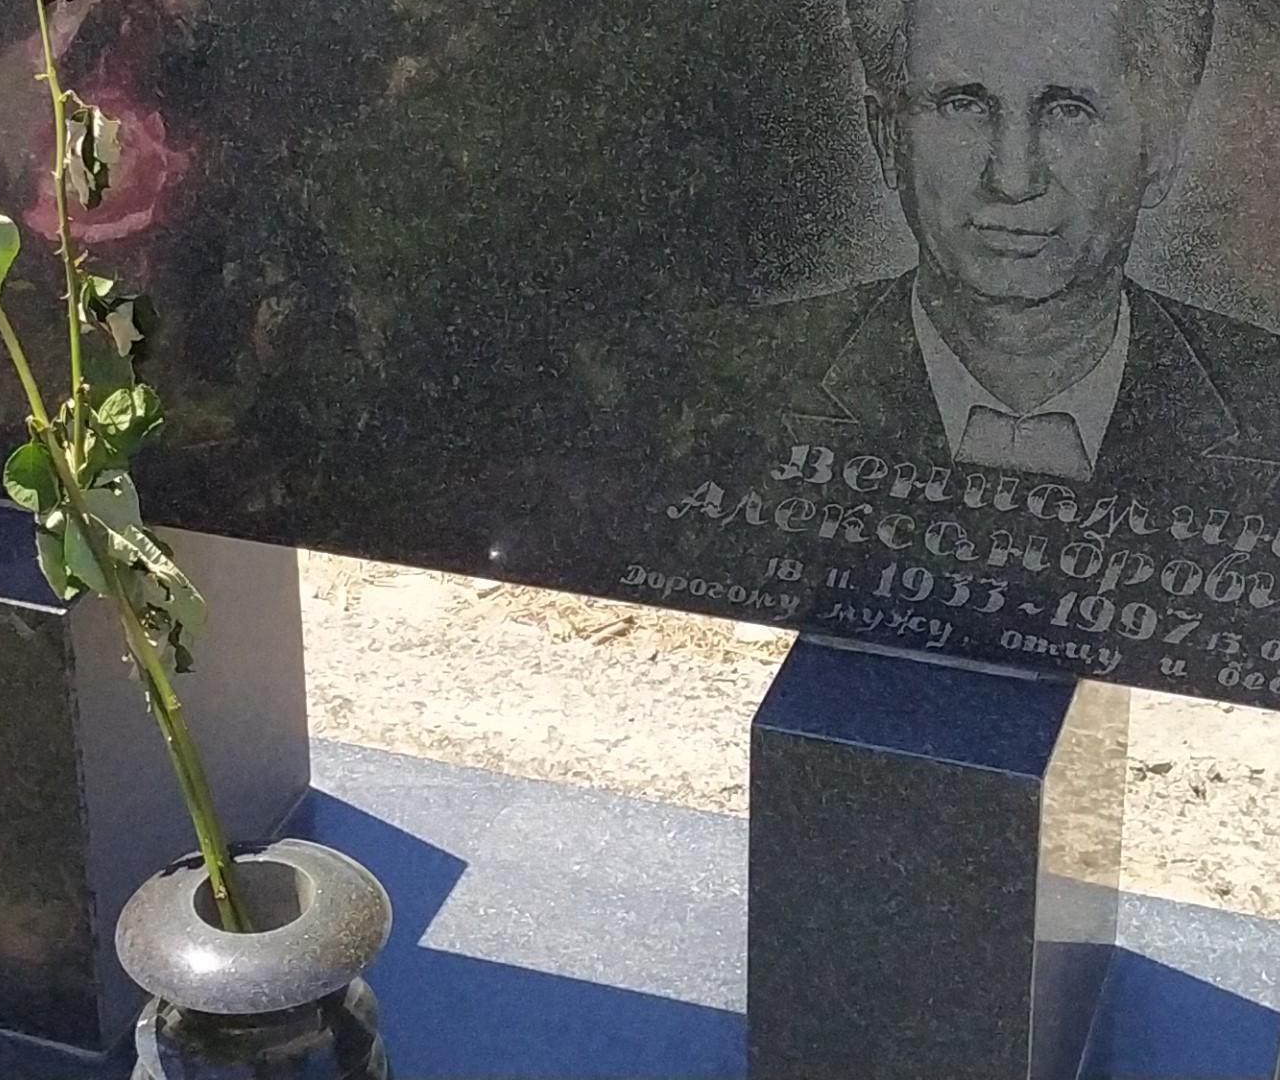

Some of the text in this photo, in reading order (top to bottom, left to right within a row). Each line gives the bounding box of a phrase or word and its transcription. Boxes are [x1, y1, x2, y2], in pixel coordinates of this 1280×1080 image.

[762, 556, 804, 583] 18
[620, 563, 801, 620] Дорогому
[1000, 628, 1122, 675] отцу
[1160, 655, 1187, 677] и
